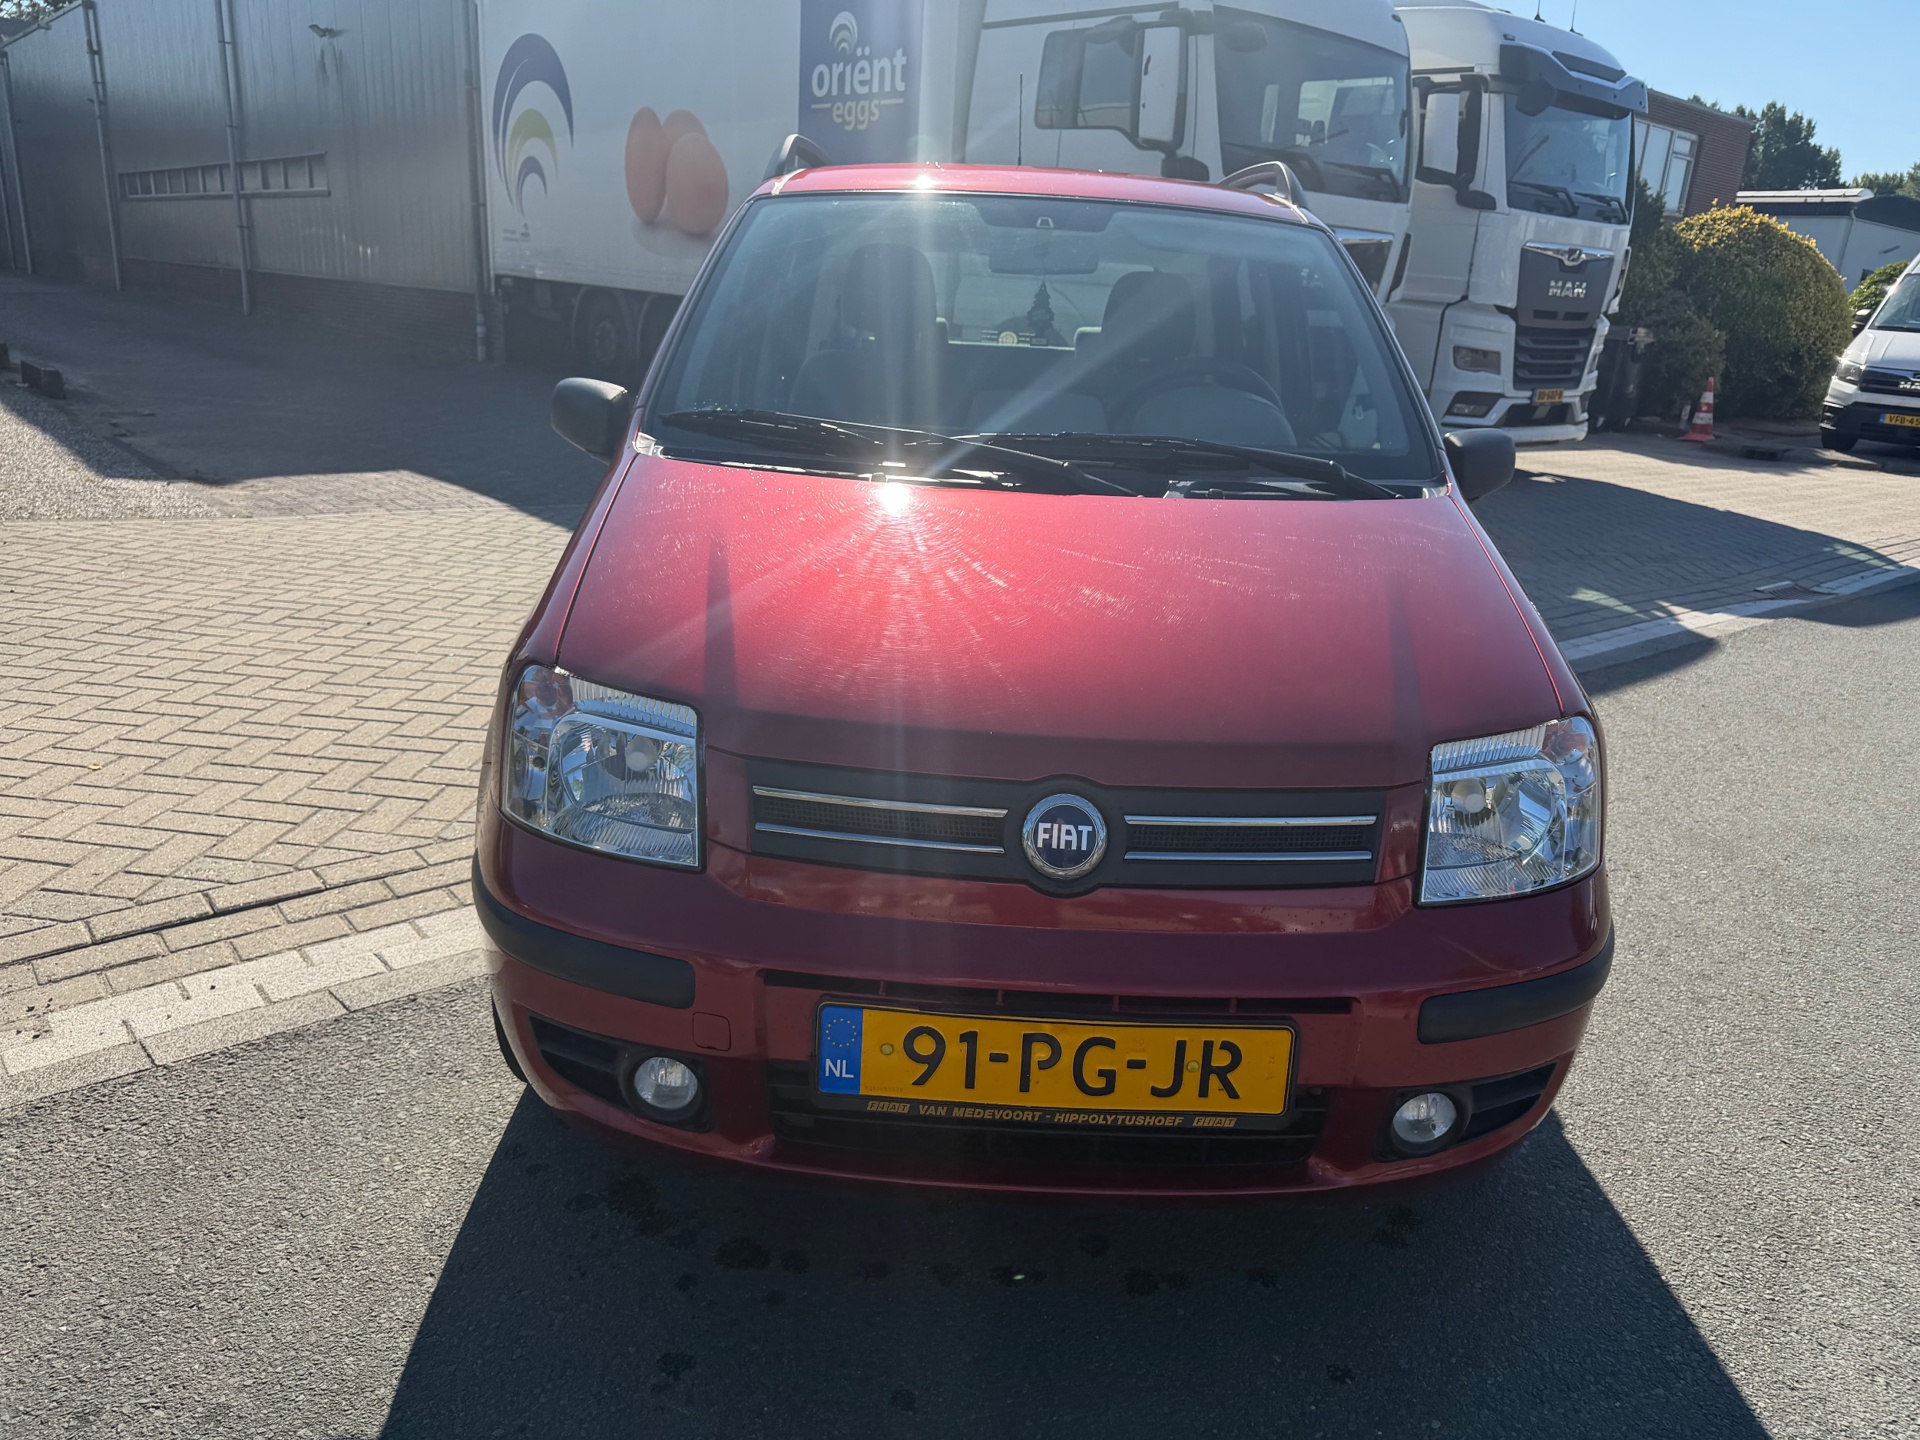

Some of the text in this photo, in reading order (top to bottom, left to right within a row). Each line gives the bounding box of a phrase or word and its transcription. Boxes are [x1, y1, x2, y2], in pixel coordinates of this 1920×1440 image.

[811, 46, 907, 98] oriënt
[832, 99, 880, 131] eggs
[1548, 280, 1587, 298] MAN
[1037, 822, 1093, 851] FIAT
[825, 1058, 854, 1079] NL
[903, 1025, 1243, 1100] 91-PG-JR
[867, 1101, 911, 1114] FIAT
[919, 1104, 947, 1117] VAN
[952, 1107, 1042, 1121] MEDEVOORT
[1054, 1113, 1184, 1126] HIPPOLYTUSHOEF
[1192, 1116, 1237, 1128] FIAT
